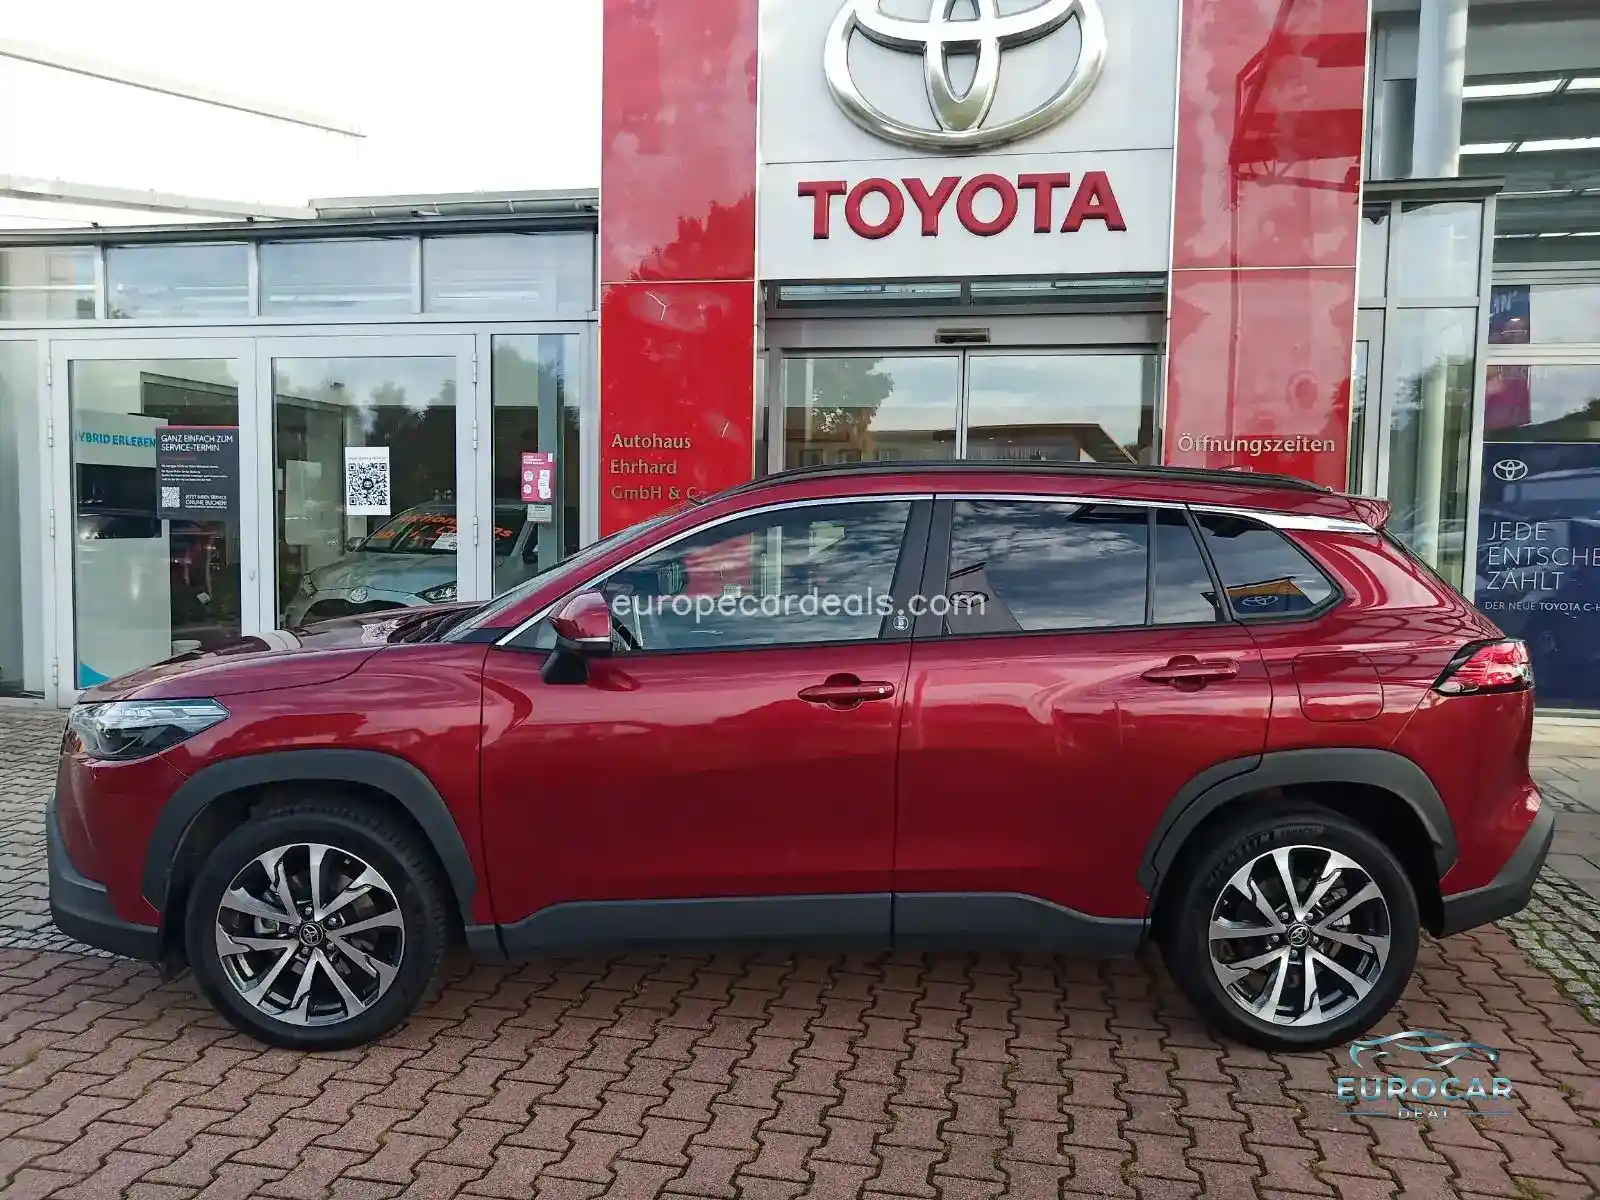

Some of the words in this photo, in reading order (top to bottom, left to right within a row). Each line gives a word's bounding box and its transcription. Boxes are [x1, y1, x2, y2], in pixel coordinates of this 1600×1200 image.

[797, 170, 1128, 240] TOYOTA
[112, 435, 156, 448] ERLEBEN
[161, 434, 183, 443] GANZ
[183, 435, 215, 443] EINFACH
[217, 435, 234, 443] ZUM
[611, 433, 692, 449] Autohaus
[1177, 432, 1335, 457] Öffnungszeiten
[161, 443, 220, 452] SERVICE-TERMIN
[610, 458, 677, 474] Ehrhard
[611, 485, 662, 500] GmbH
[668, 486, 680, 500] &
[1486, 521, 1548, 541] JEDE
[1488, 546, 1600, 567] ENTSCHE
[1486, 567, 1565, 591] ZÄHLT
[1485, 601, 1506, 611] DER
[1508, 602, 1537, 611] NEUE
[1540, 602, 1581, 611] TOYOTA
